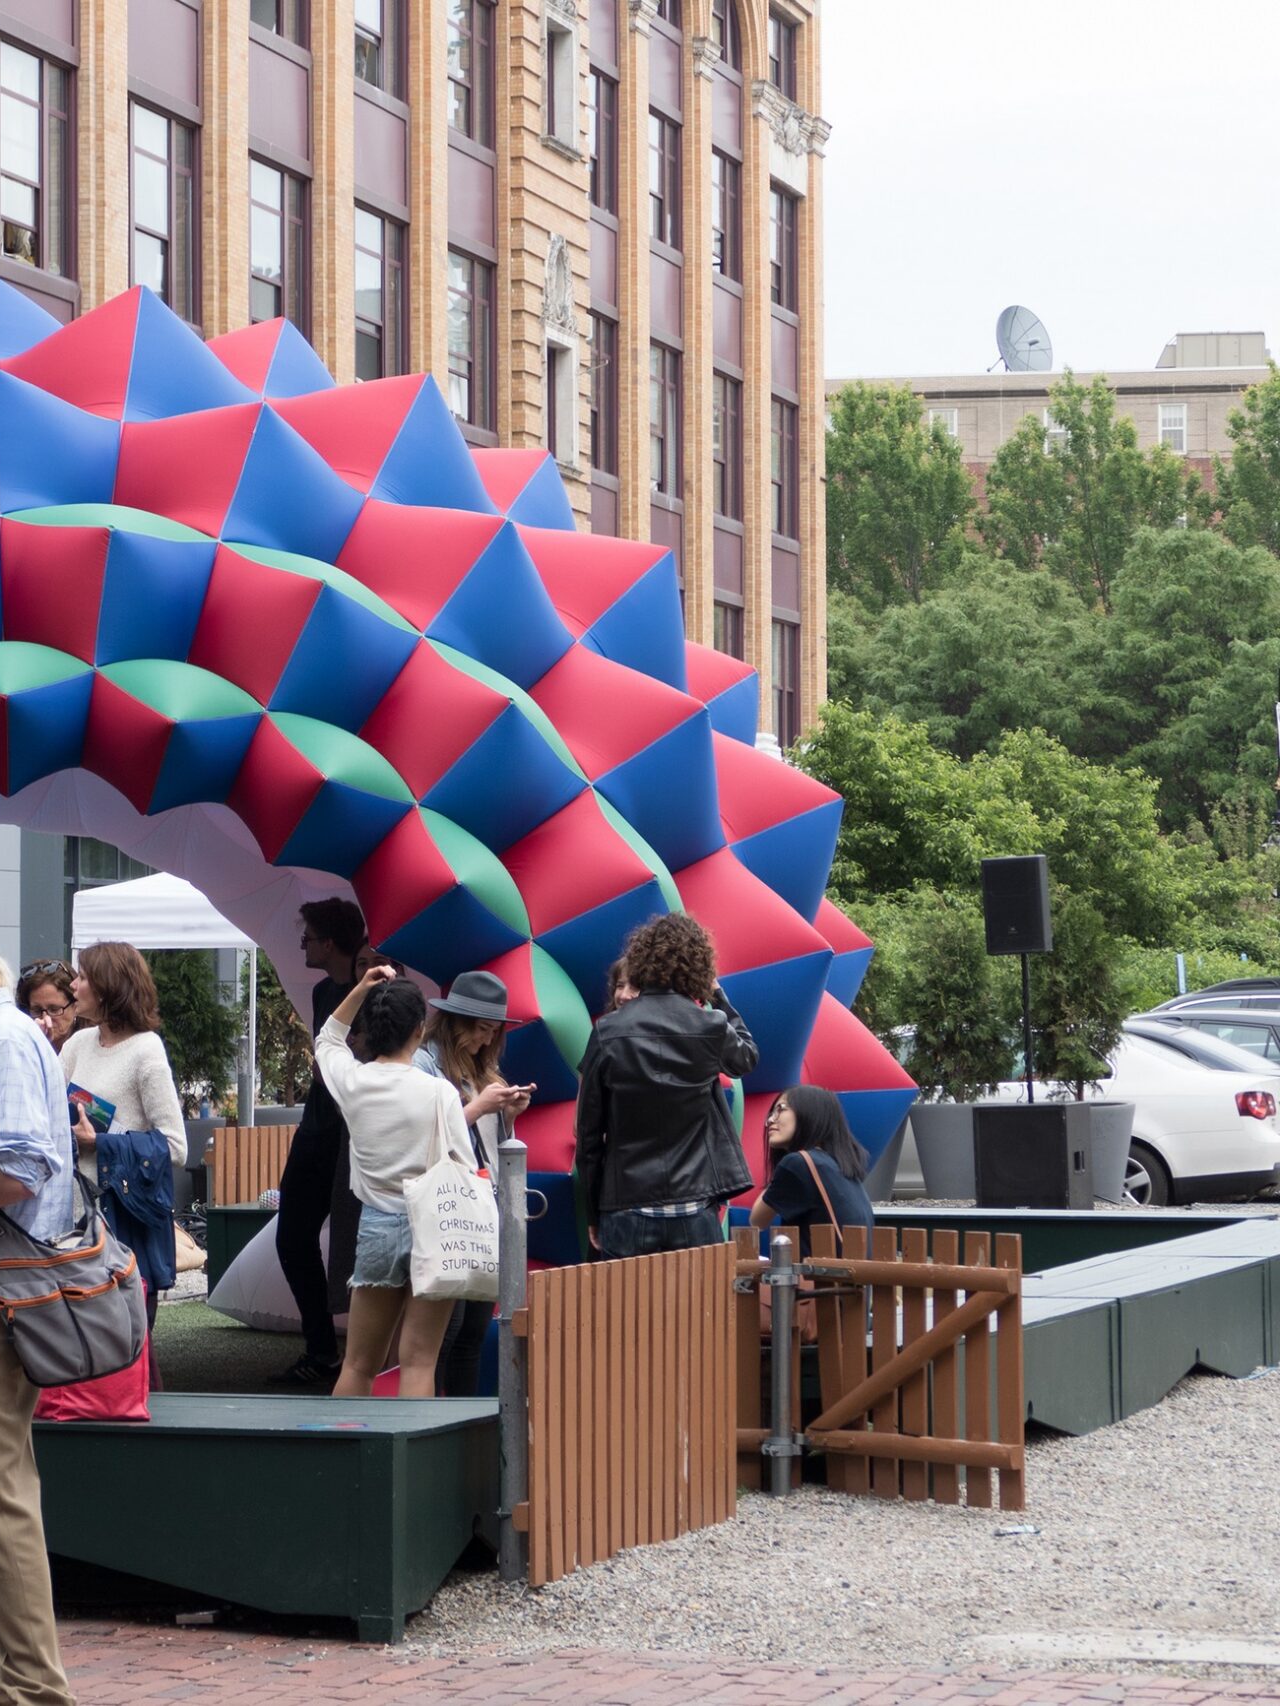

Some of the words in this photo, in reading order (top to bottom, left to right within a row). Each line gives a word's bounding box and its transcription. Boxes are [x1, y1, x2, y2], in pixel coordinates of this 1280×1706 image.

[436, 1182, 451, 1197] ALL
[437, 1200, 457, 1214] FOR
[439, 1218, 495, 1234] CHRISTMAS
[440, 1240, 467, 1252] WAS
[470, 1241, 493, 1255] THIS
[442, 1258, 479, 1271] STUPID
